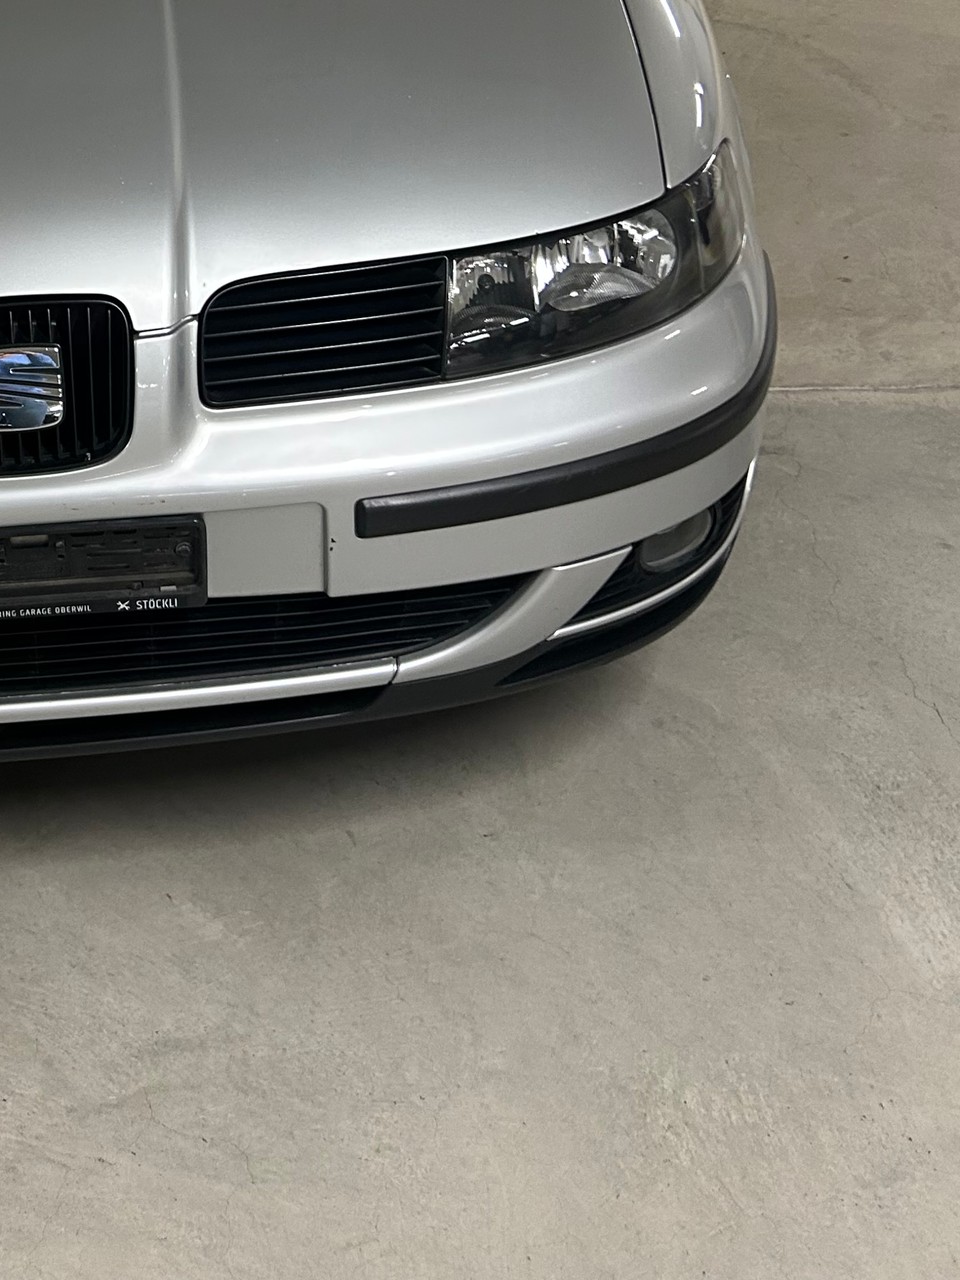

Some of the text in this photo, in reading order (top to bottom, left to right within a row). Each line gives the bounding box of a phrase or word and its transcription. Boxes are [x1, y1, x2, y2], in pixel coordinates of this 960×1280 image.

[19, 607, 52, 616] GARAGE
[54, 605, 91, 614] OBERWIL
[136, 598, 178, 610] STÖCKLI
